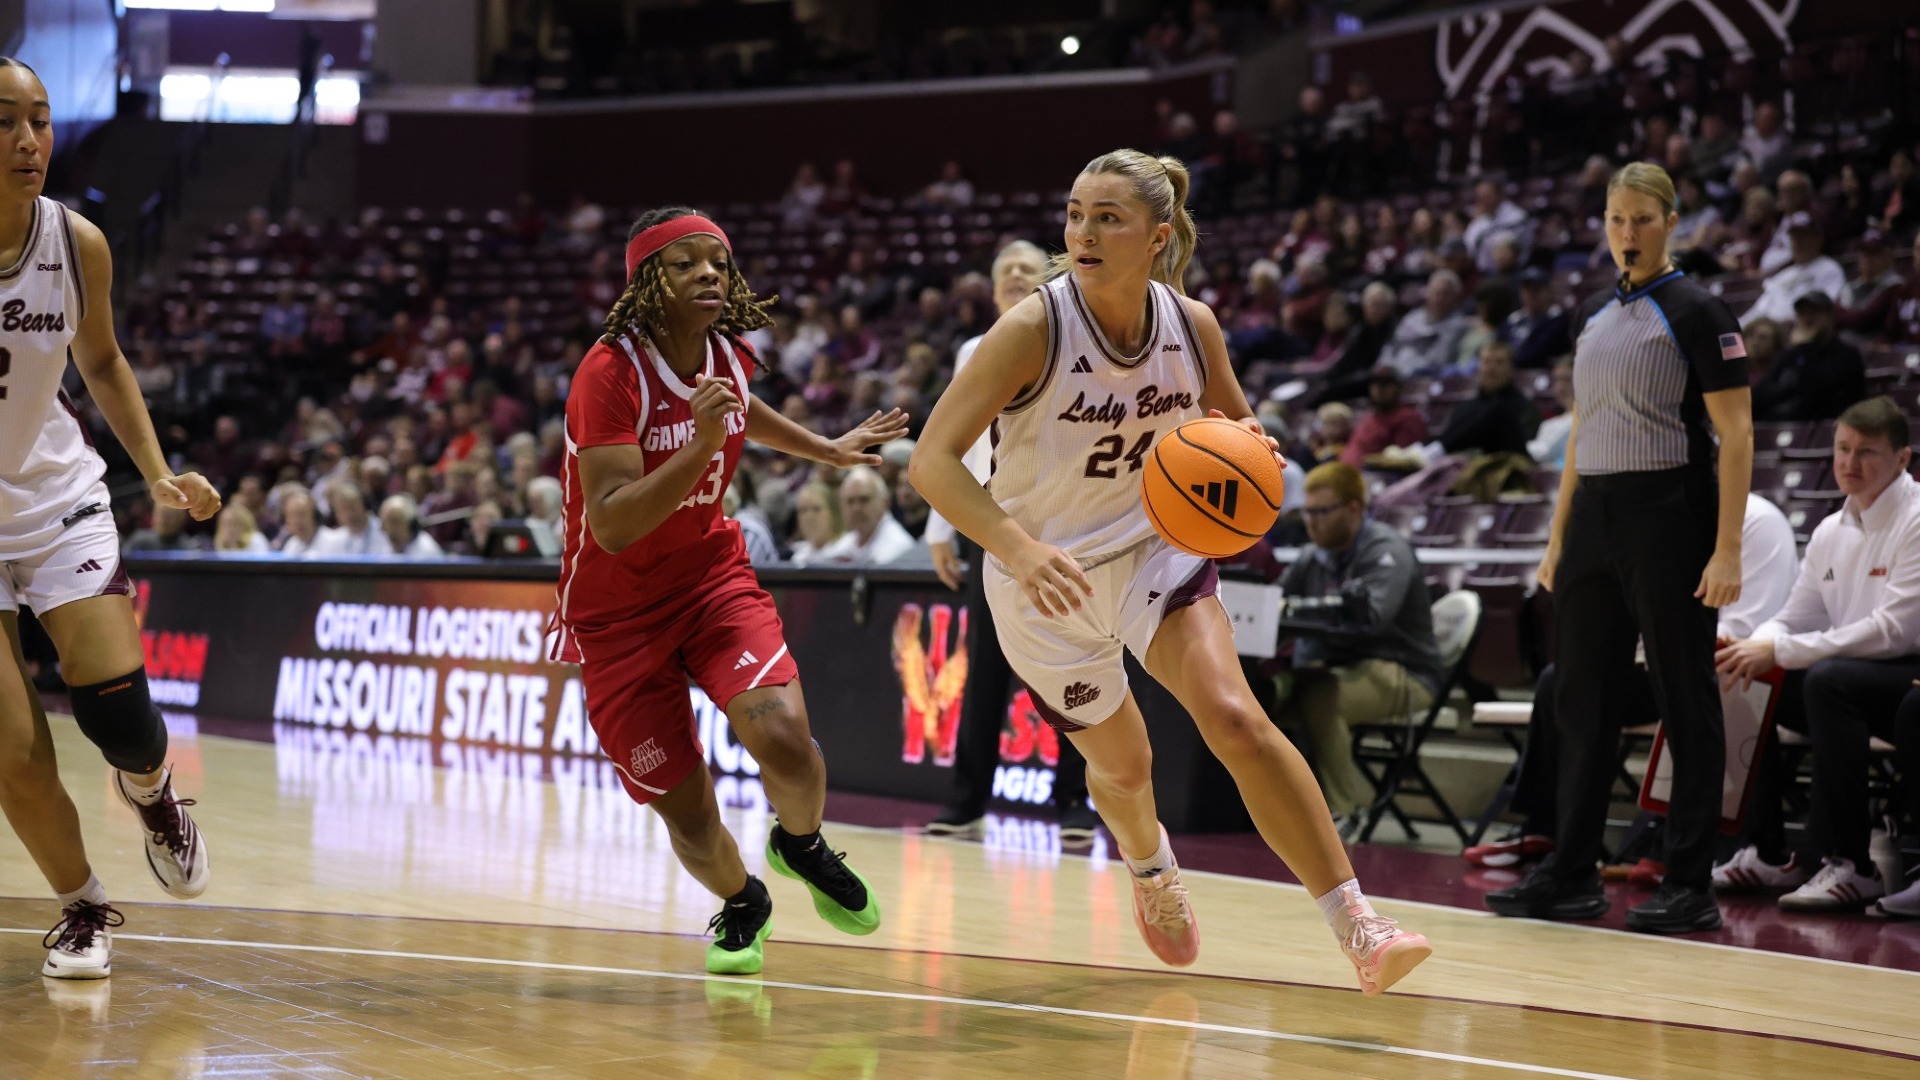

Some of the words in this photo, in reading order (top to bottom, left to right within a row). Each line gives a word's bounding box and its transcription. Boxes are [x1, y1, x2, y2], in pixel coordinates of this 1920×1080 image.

[2, 298, 65, 332] Bears
[1057, 390, 1128, 430] Lady
[1135, 384, 1194, 419] Bears
[1083, 428, 1157, 480] 24
[315, 601, 413, 656] OFFICIAL
[414, 606, 543, 664] LOGISTICS
[273, 655, 438, 736] MISSOURI
[440, 667, 550, 748] STATE
[1063, 681, 1091, 700] Mo
[1064, 686, 1102, 710] State
[630, 736, 660, 765] JAX
[631, 747, 668, 778] STATE
